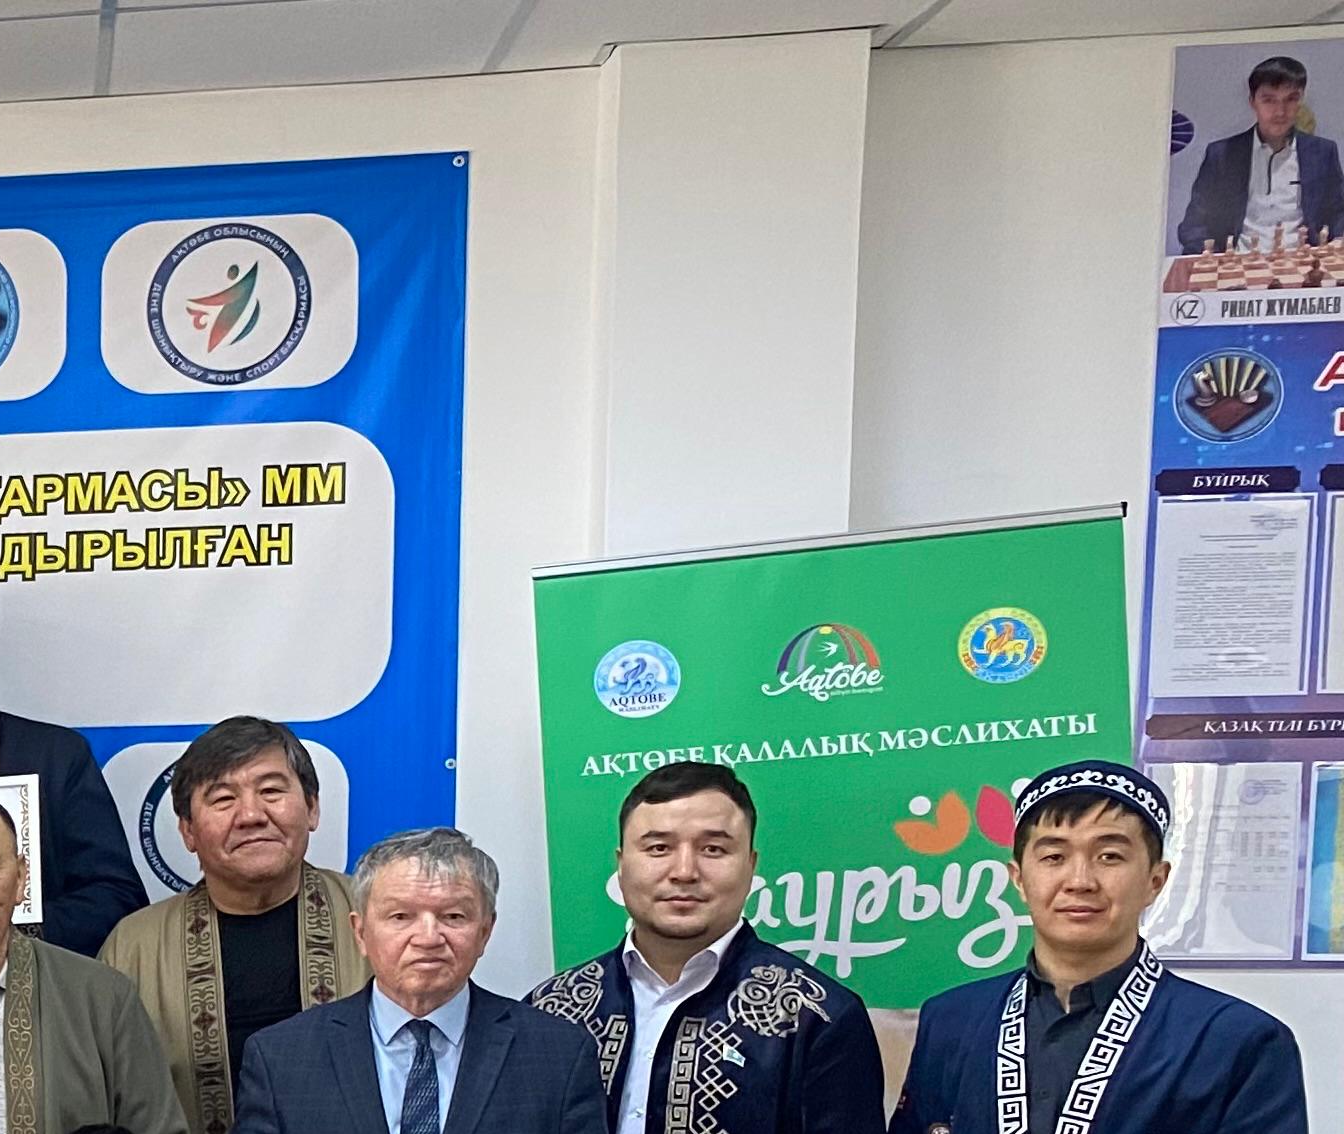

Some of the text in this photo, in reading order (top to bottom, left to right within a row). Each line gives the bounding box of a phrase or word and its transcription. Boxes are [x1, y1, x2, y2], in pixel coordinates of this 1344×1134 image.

[1176, 299, 1199, 320] KZ
[1221, 299, 1263, 318] РИНАТ
[261, 461, 346, 508] ММ
[712, 731, 874, 769] ҚАЛАЛЫҚ
[878, 712, 1098, 751] МӘСЛИХАТЫ
